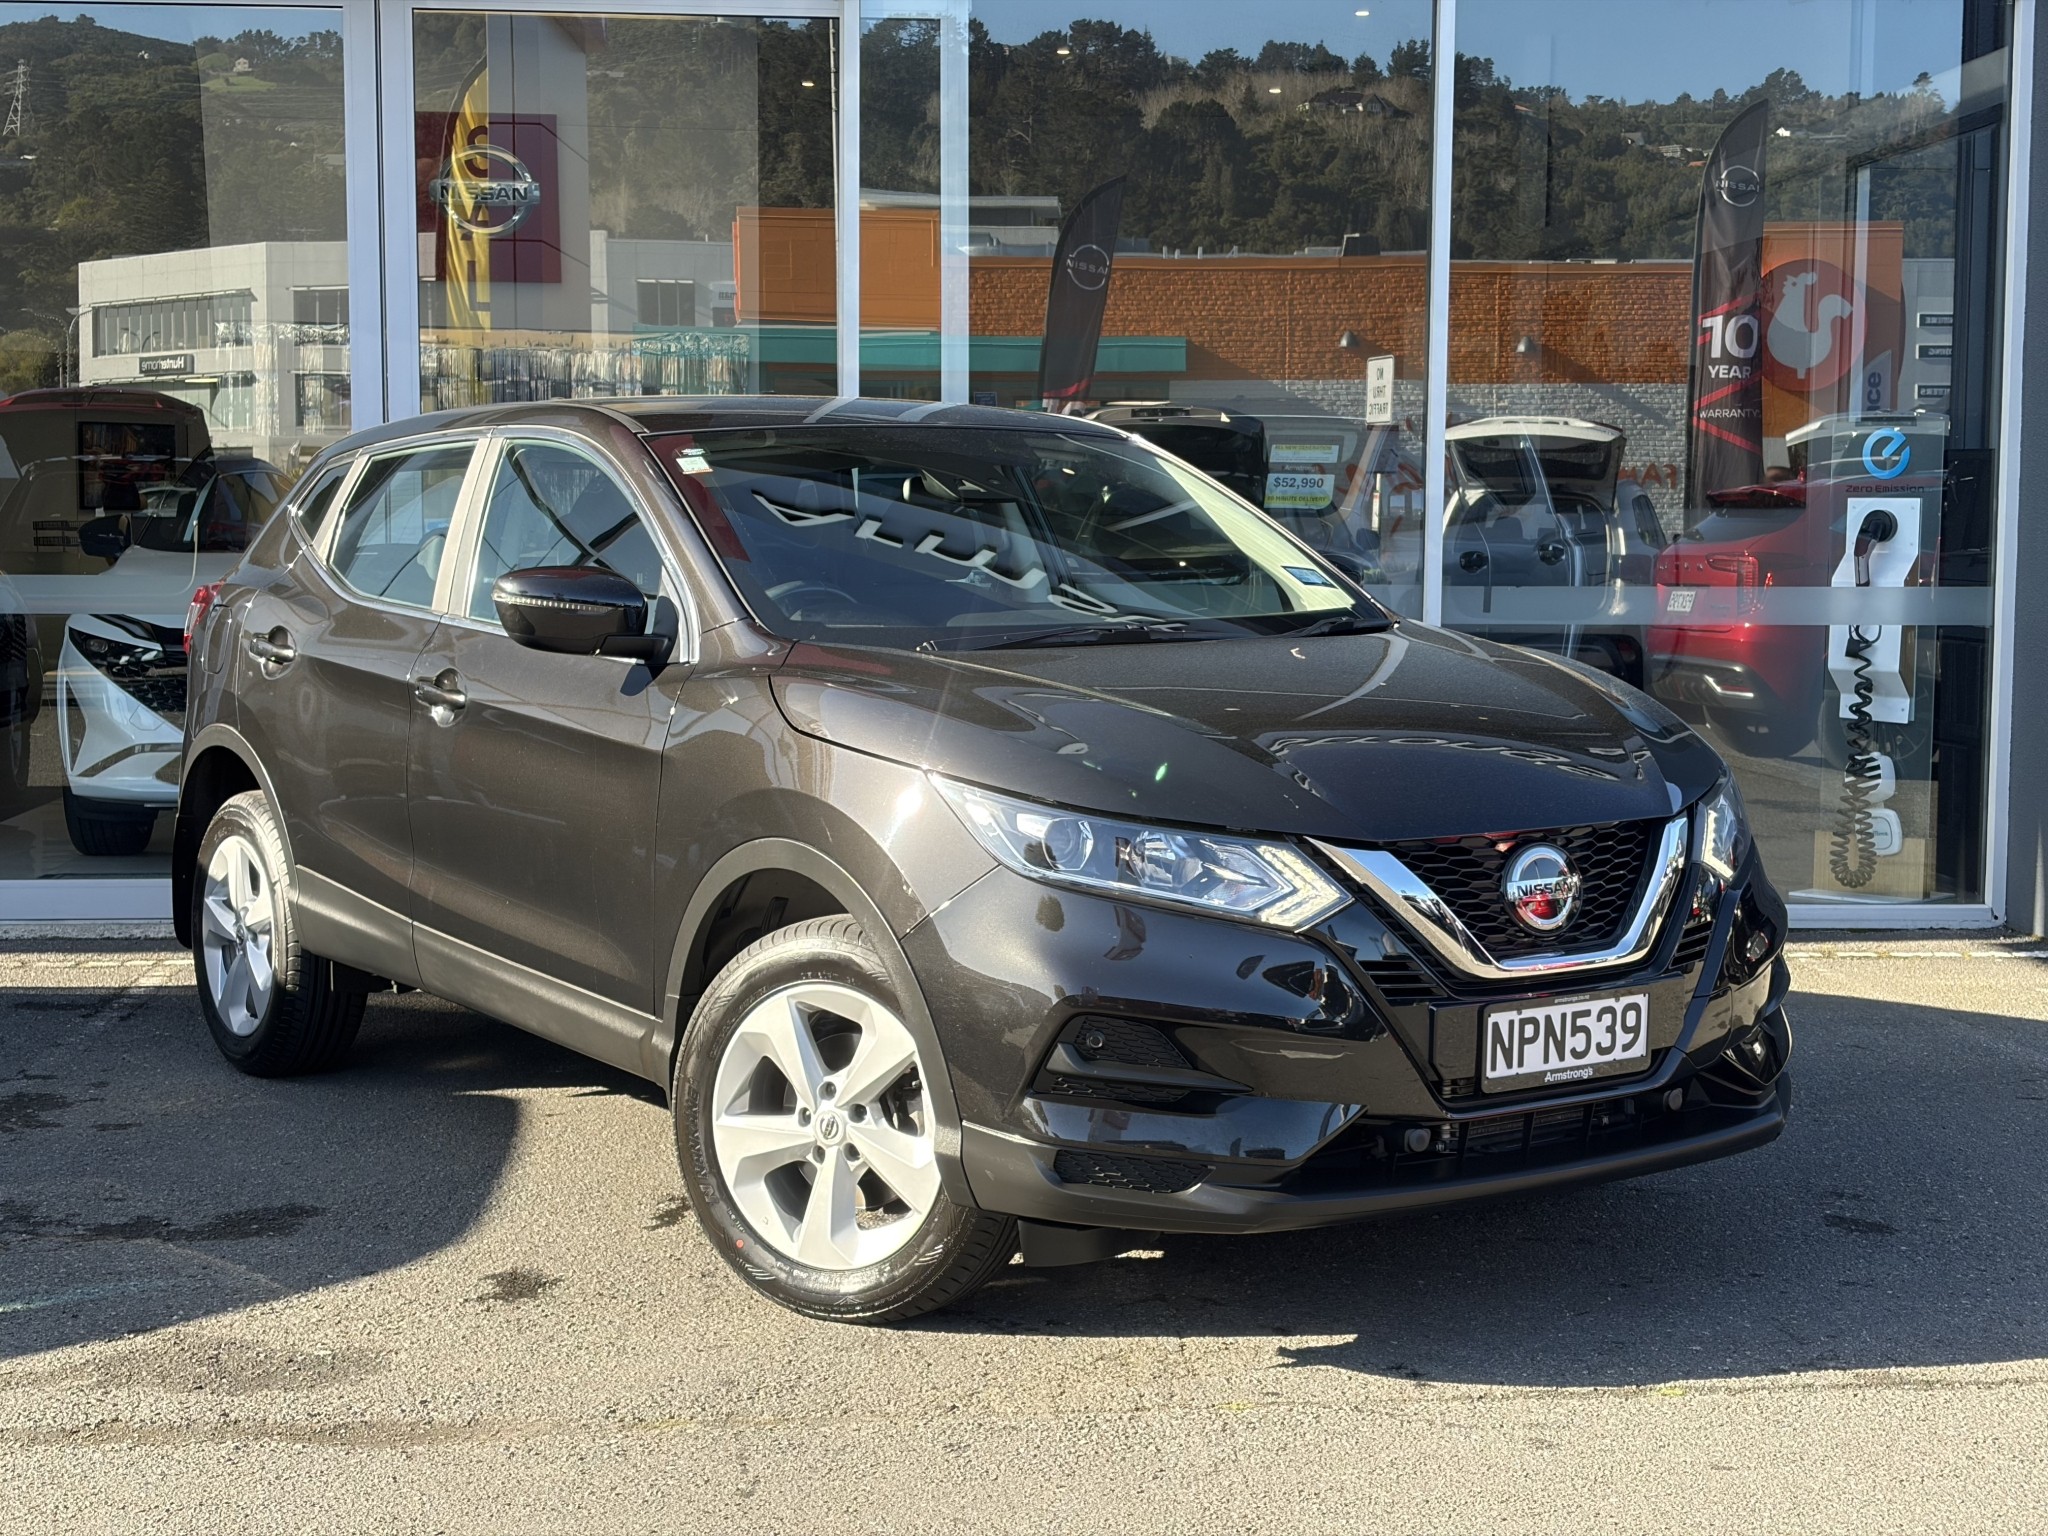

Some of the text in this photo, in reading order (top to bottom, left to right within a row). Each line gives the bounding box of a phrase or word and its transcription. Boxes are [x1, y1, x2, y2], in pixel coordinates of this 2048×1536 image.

[440, 185, 528, 201] NISSAN
[1702, 315, 1759, 358] 10
[1708, 365, 1752, 378] YEAR
[1273, 476, 1324, 489] $52,990
[1845, 484, 1925, 493] Zero Emission
[1516, 880, 1574, 897] NISSAN
[1490, 1002, 1642, 1072] NPN539
[1544, 1066, 1594, 1082] Armstrong's
